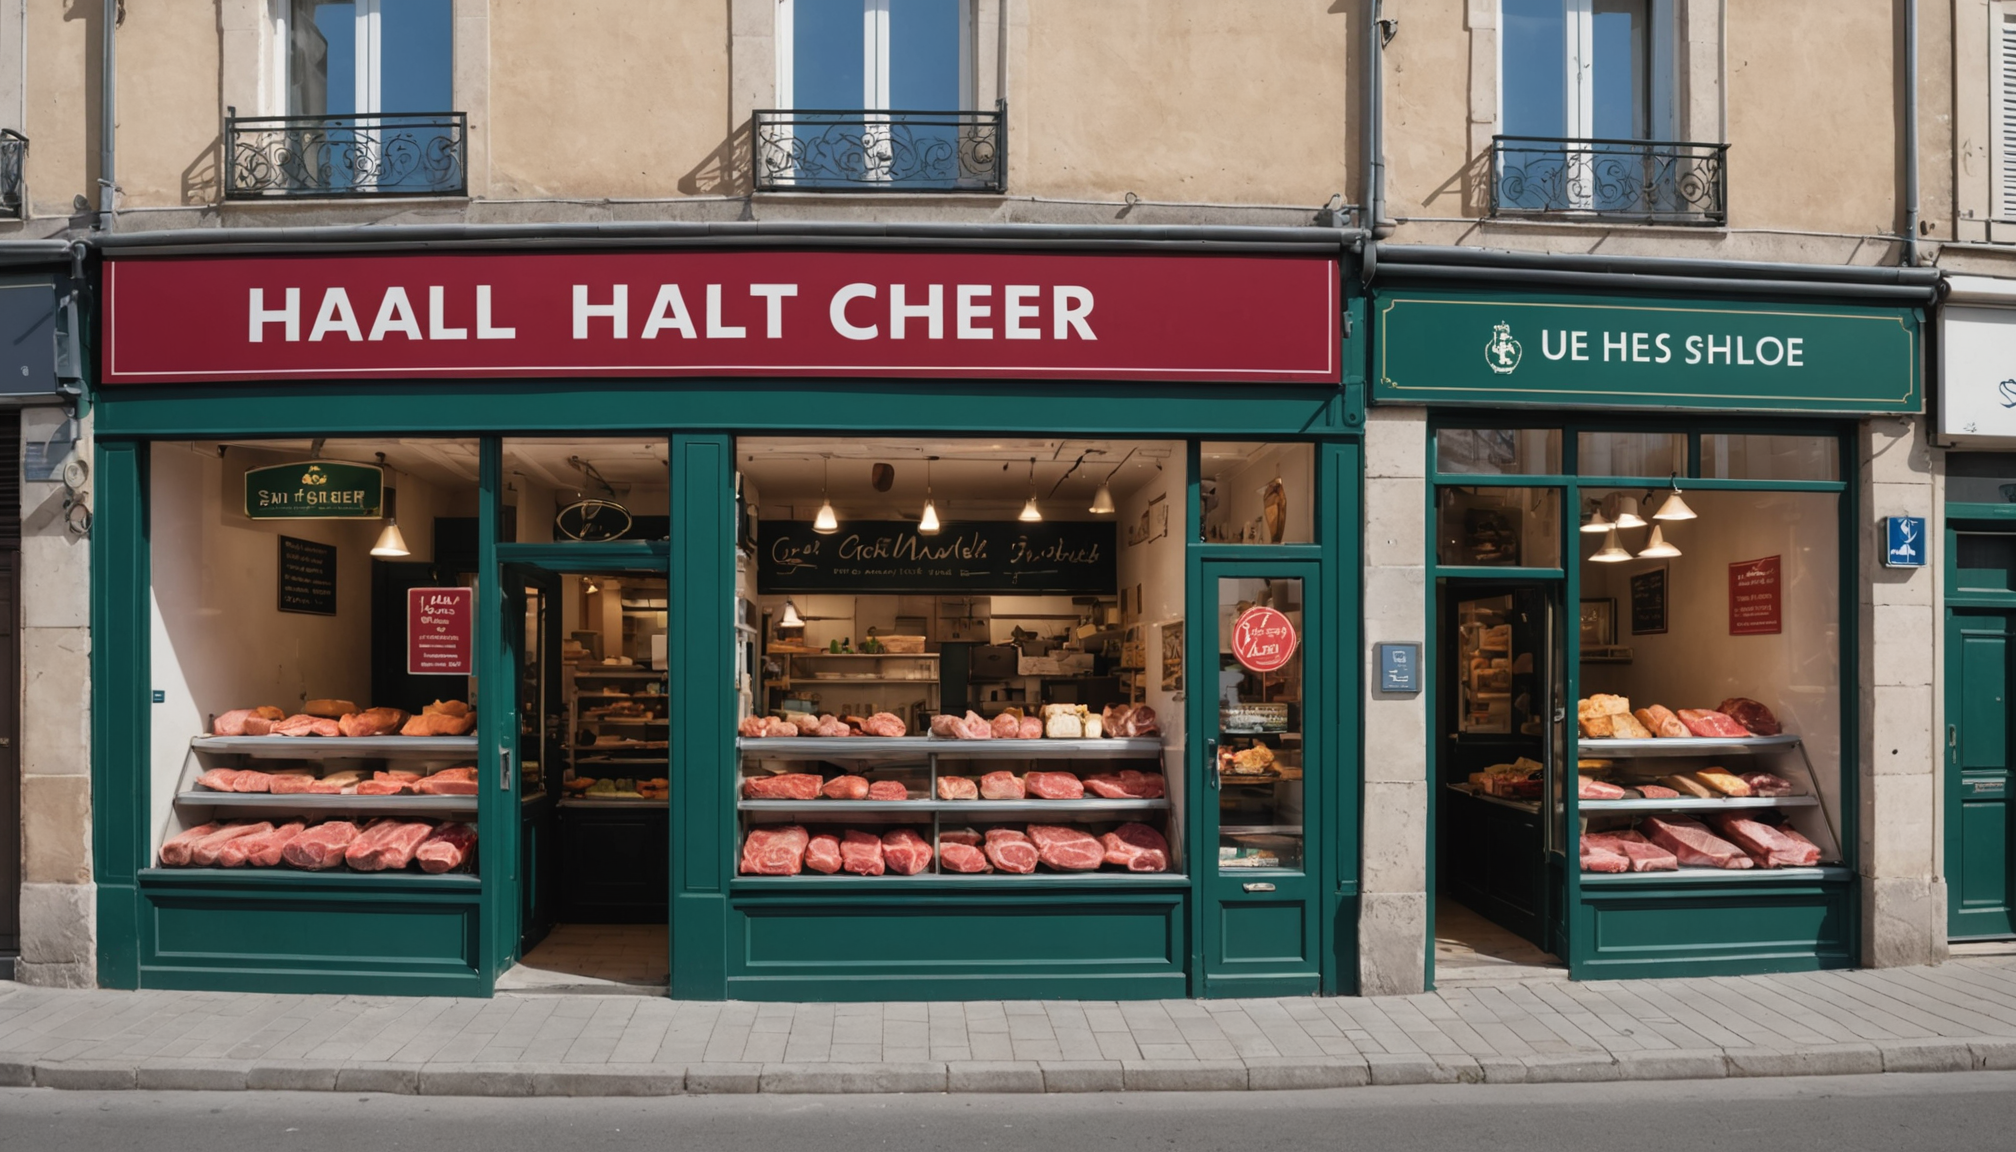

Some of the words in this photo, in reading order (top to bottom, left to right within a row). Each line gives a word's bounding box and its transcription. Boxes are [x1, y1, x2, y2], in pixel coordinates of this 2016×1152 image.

[248, 284, 516, 343] HAALL
[572, 283, 798, 340] HALT
[829, 282, 1099, 341] CHEER
[1541, 329, 1590, 361] UE
[1603, 331, 1672, 364] HES
[1685, 334, 1805, 367] SHLOE
